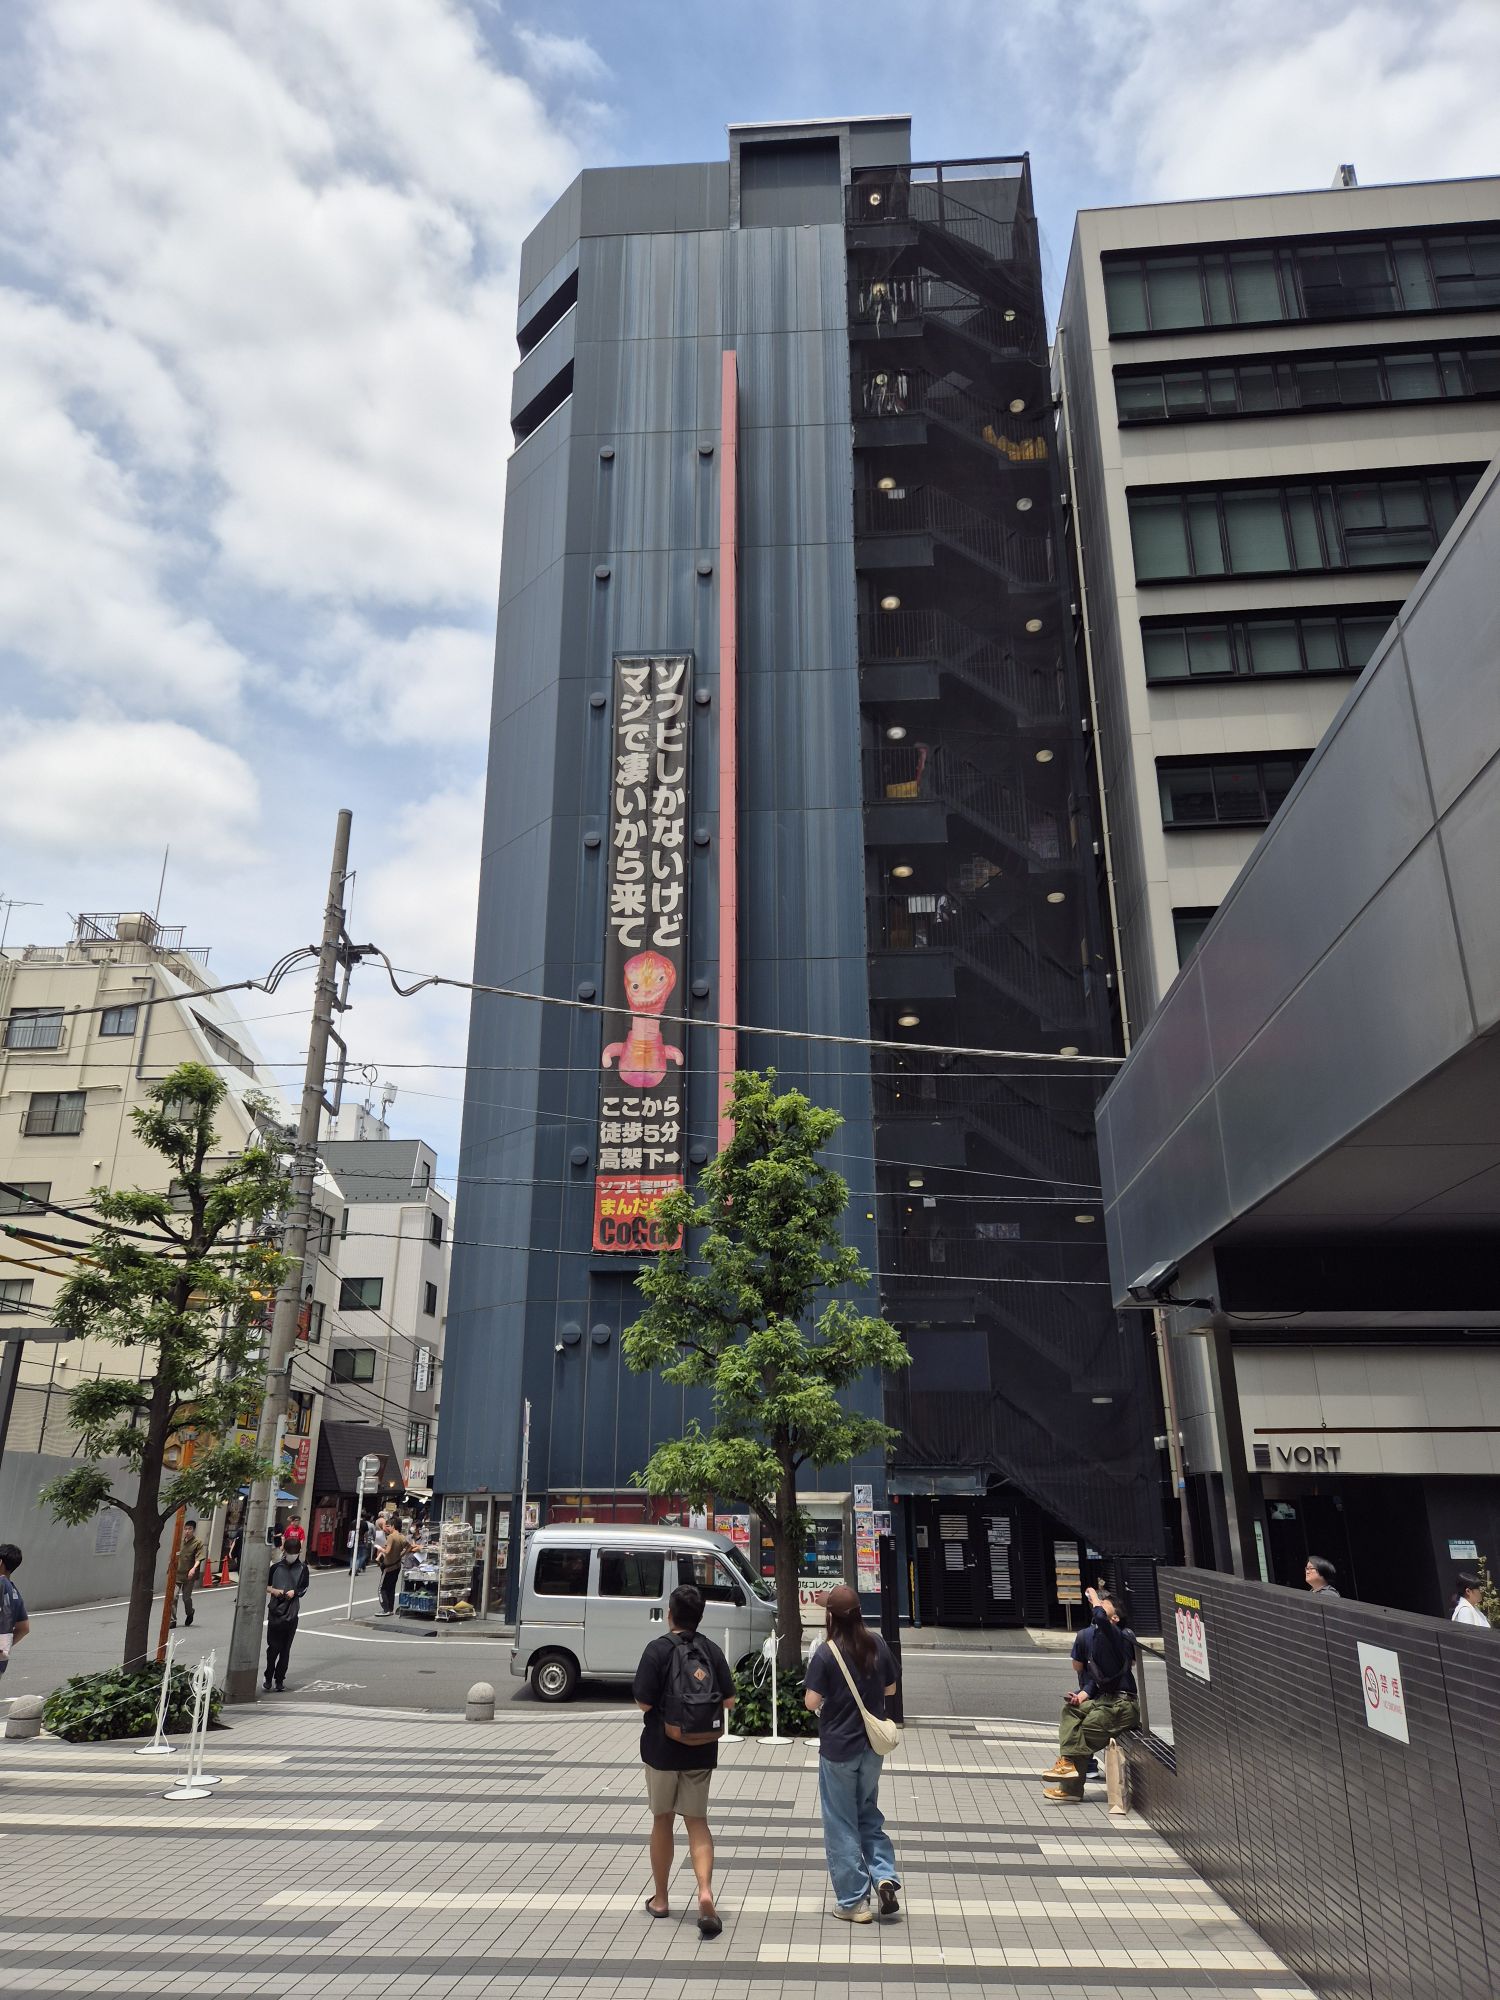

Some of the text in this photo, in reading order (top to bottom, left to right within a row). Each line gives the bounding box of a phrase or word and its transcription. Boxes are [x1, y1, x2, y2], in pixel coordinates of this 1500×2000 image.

[610, 666, 651, 949] マジで凄いから来て
[651, 664, 685, 947] ソフビしかないけど
[602, 1096, 680, 1117] ここから
[600, 1121, 681, 1143] 徒歩5分
[600, 1148, 664, 1170] 高架下
[1276, 1446, 1341, 1465] VORT
